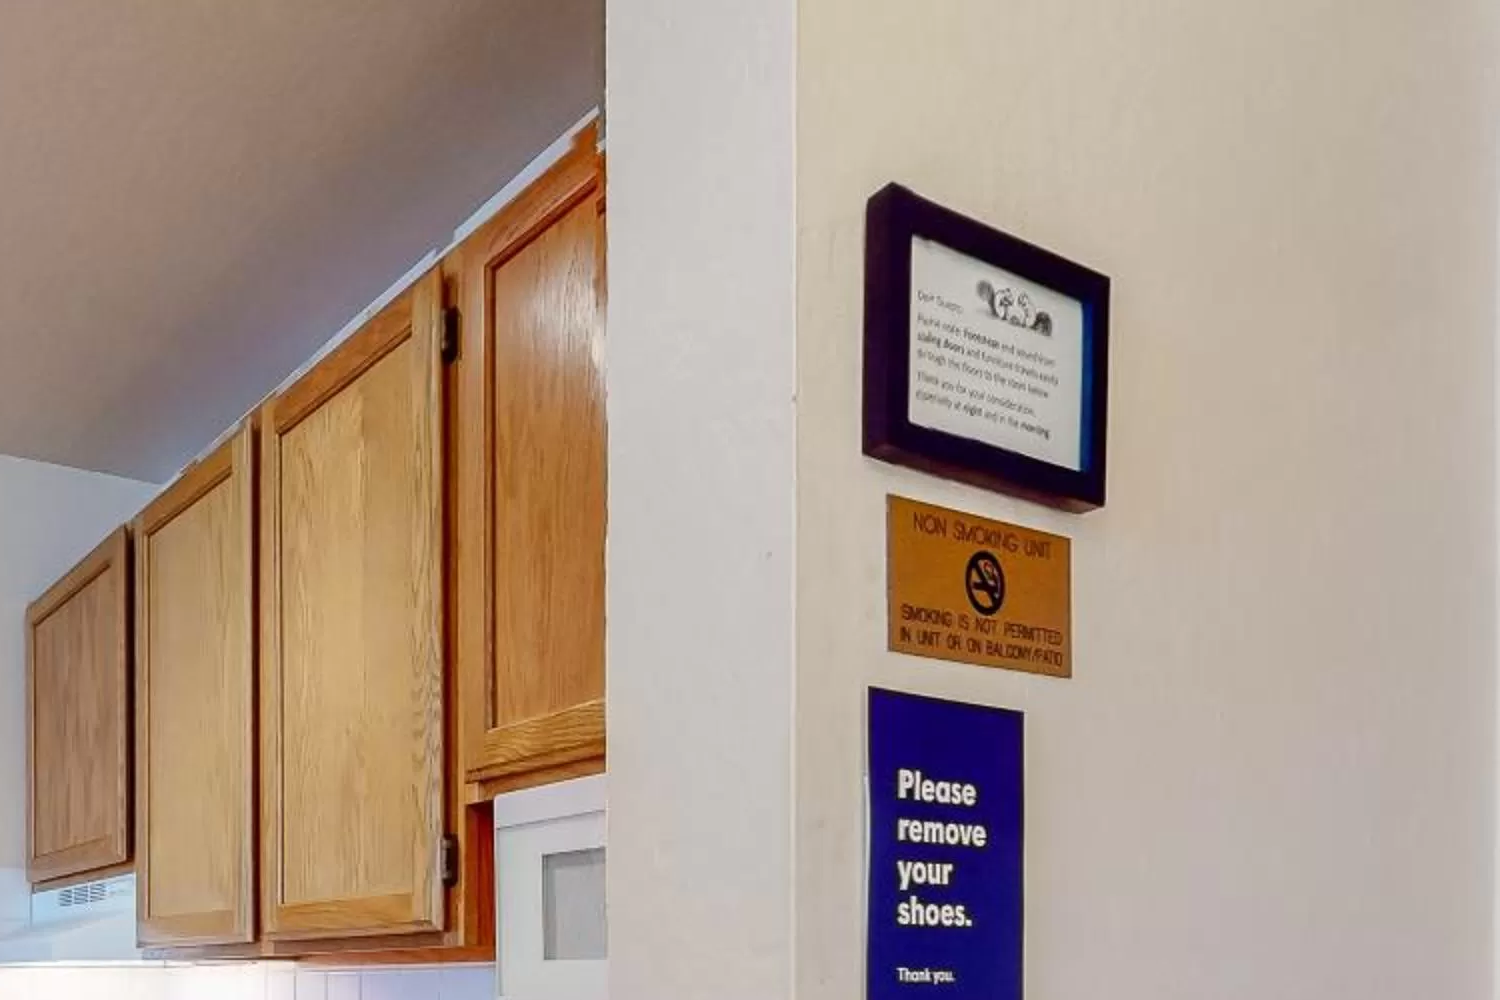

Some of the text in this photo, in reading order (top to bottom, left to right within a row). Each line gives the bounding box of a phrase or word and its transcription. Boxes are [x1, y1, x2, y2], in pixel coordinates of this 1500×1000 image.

[914, 512, 1051, 558] NON SMOKING UNIT
[902, 604, 1062, 645] SMOKING IS NOT PERMITTED
[900, 627, 911, 641] IN
[917, 629, 940, 646] UNIT
[946, 633, 960, 650] OR
[967, 637, 982, 653] ON
[898, 768, 977, 807] Please
[897, 817, 987, 847] remove
[897, 860, 953, 890] your
[897, 896, 973, 927] shoes.
[897, 967, 955, 985] Thank you.
